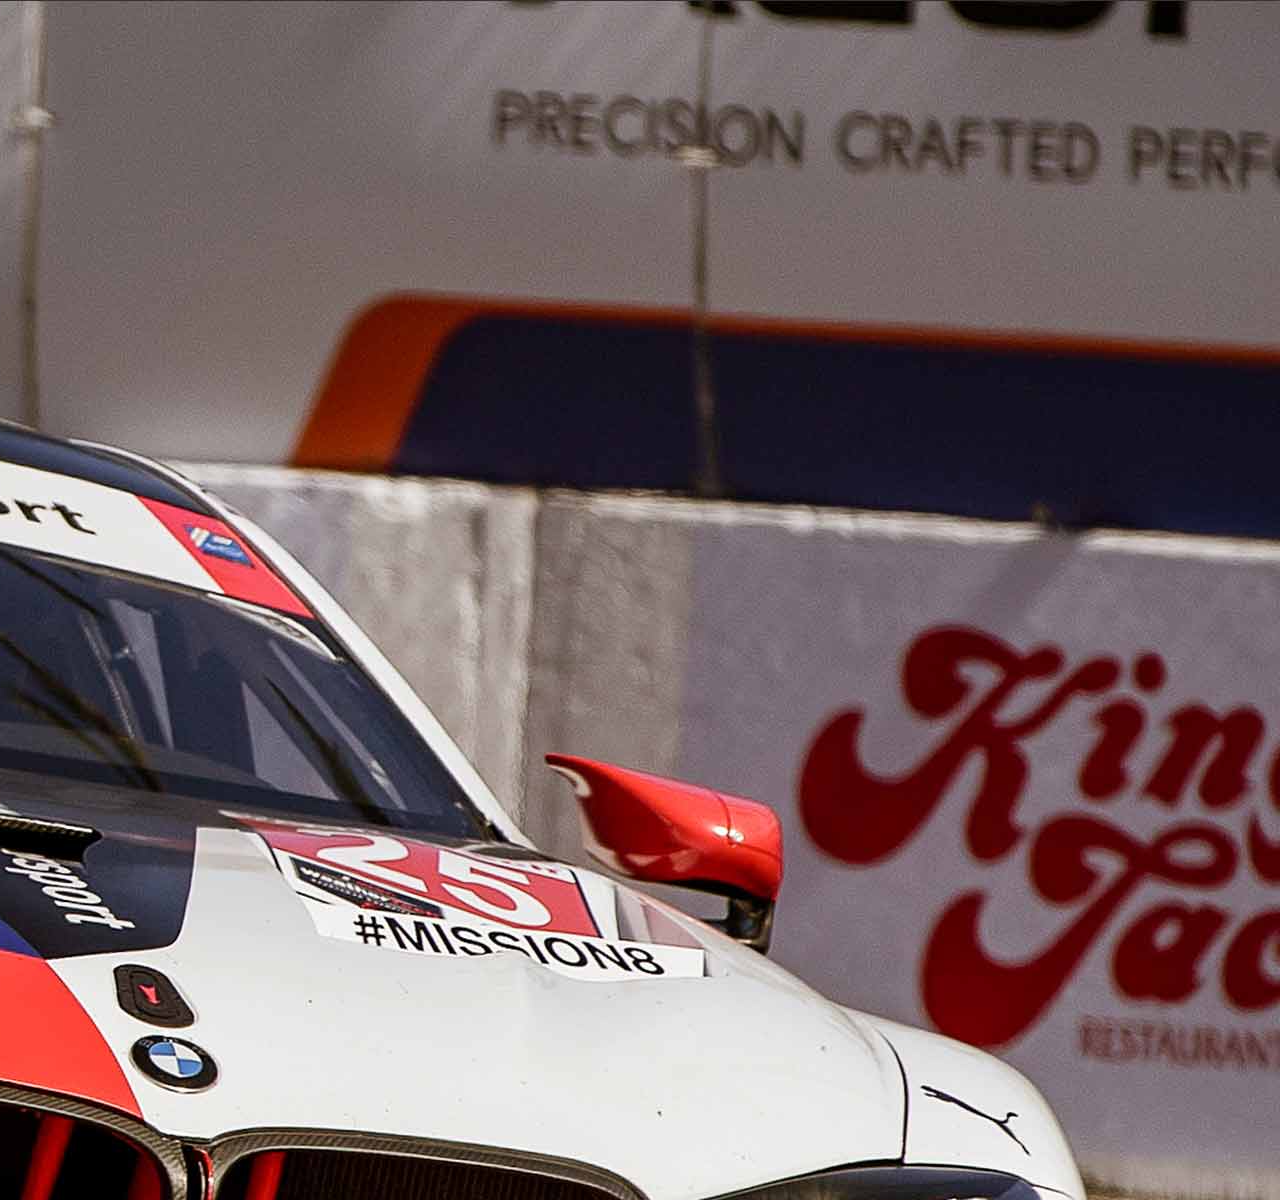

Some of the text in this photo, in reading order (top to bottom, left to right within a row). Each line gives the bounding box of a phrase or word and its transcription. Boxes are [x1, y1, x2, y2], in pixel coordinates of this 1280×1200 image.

[490, 87, 1280, 192] PRECISION CRAFTED PERF
[300, 828, 553, 927] 25
[353, 914, 665, 977] #MISSION8
